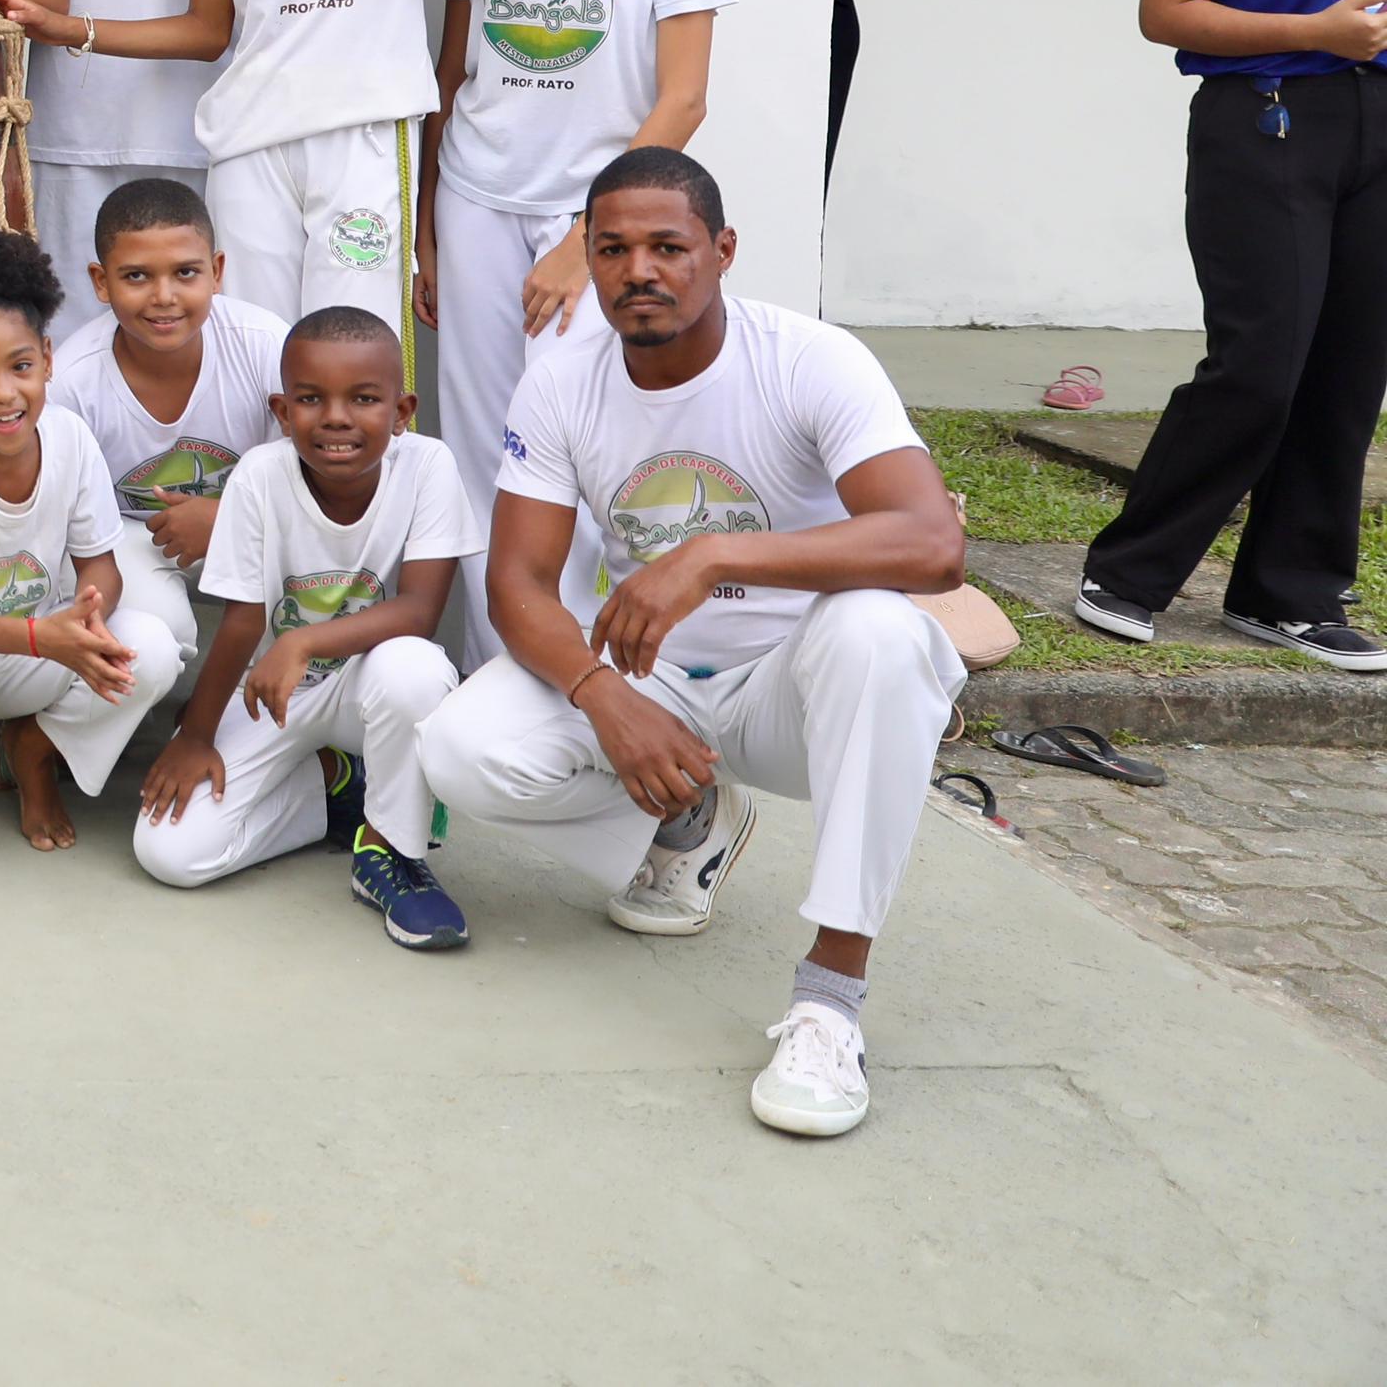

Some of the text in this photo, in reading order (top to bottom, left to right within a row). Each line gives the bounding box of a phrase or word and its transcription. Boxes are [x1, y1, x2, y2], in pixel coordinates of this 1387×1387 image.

[497, 39, 587, 68] MESTRE NAZARENO
[502, 76, 575, 90] PROF. RATO
[177, 441, 232, 464] CAPOEIRA
[620, 456, 744, 502] ESCOLA DE CAPOEIRA
[321, 575, 336, 586] DE
[709, 586, 746, 600] OBO
